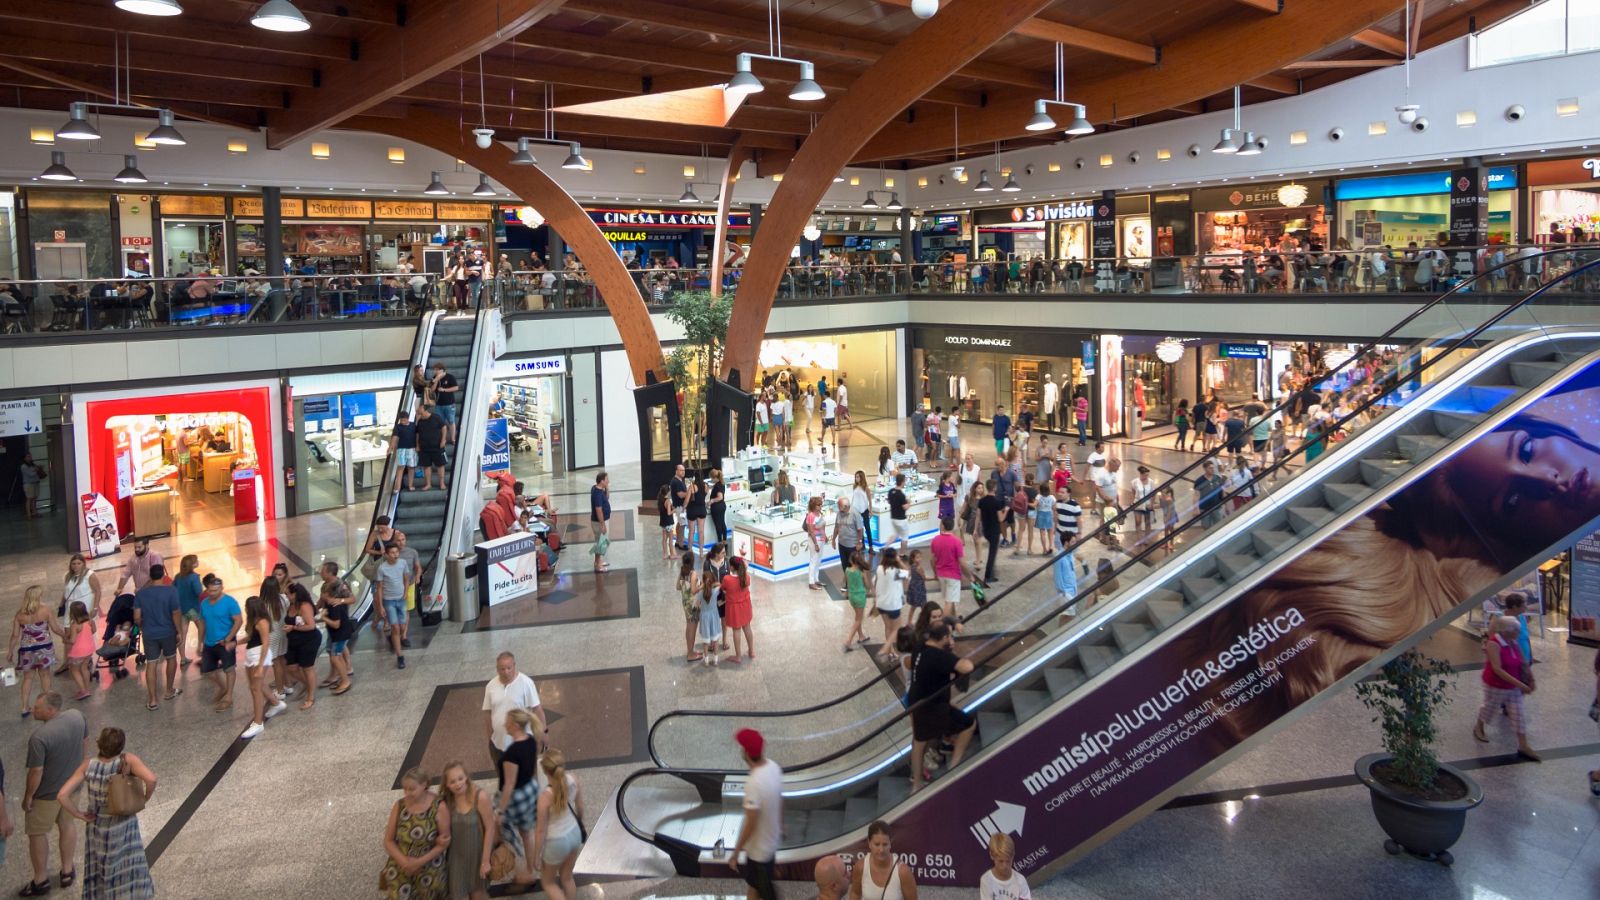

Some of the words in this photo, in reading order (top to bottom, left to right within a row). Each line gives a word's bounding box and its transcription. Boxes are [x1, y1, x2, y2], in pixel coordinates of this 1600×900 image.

[1245, 193, 1279, 202] BEHE
[1026, 202, 1094, 221] Solvisión
[604, 212, 654, 224] CINESA
[659, 214, 677, 225] LA
[603, 231, 647, 242] AQUILLAS
[945, 336, 969, 344] ADOLFO
[515, 360, 560, 371] SAMSUNG
[481, 452, 509, 465] GRATIS
[494, 580, 510, 591] Pide
[511, 577, 519, 586] tu
[520, 574, 533, 583] cita
[1044, 782, 1085, 812] COIFFURE
[1081, 775, 1093, 789] ET
[1091, 756, 1122, 781] BEAUTÉ
[1177, 717, 1186, 727] &
[1184, 697, 1216, 723] BEAUTY
[1220, 671, 1257, 699] FRISSEUR
[1254, 659, 1276, 677] UND
[1275, 633, 1317, 665] KOSMETIK
[925, 854, 953, 867] 650
[1013, 846, 1050, 871] ÉRASTASE
[917, 867, 956, 879] FLOOR
